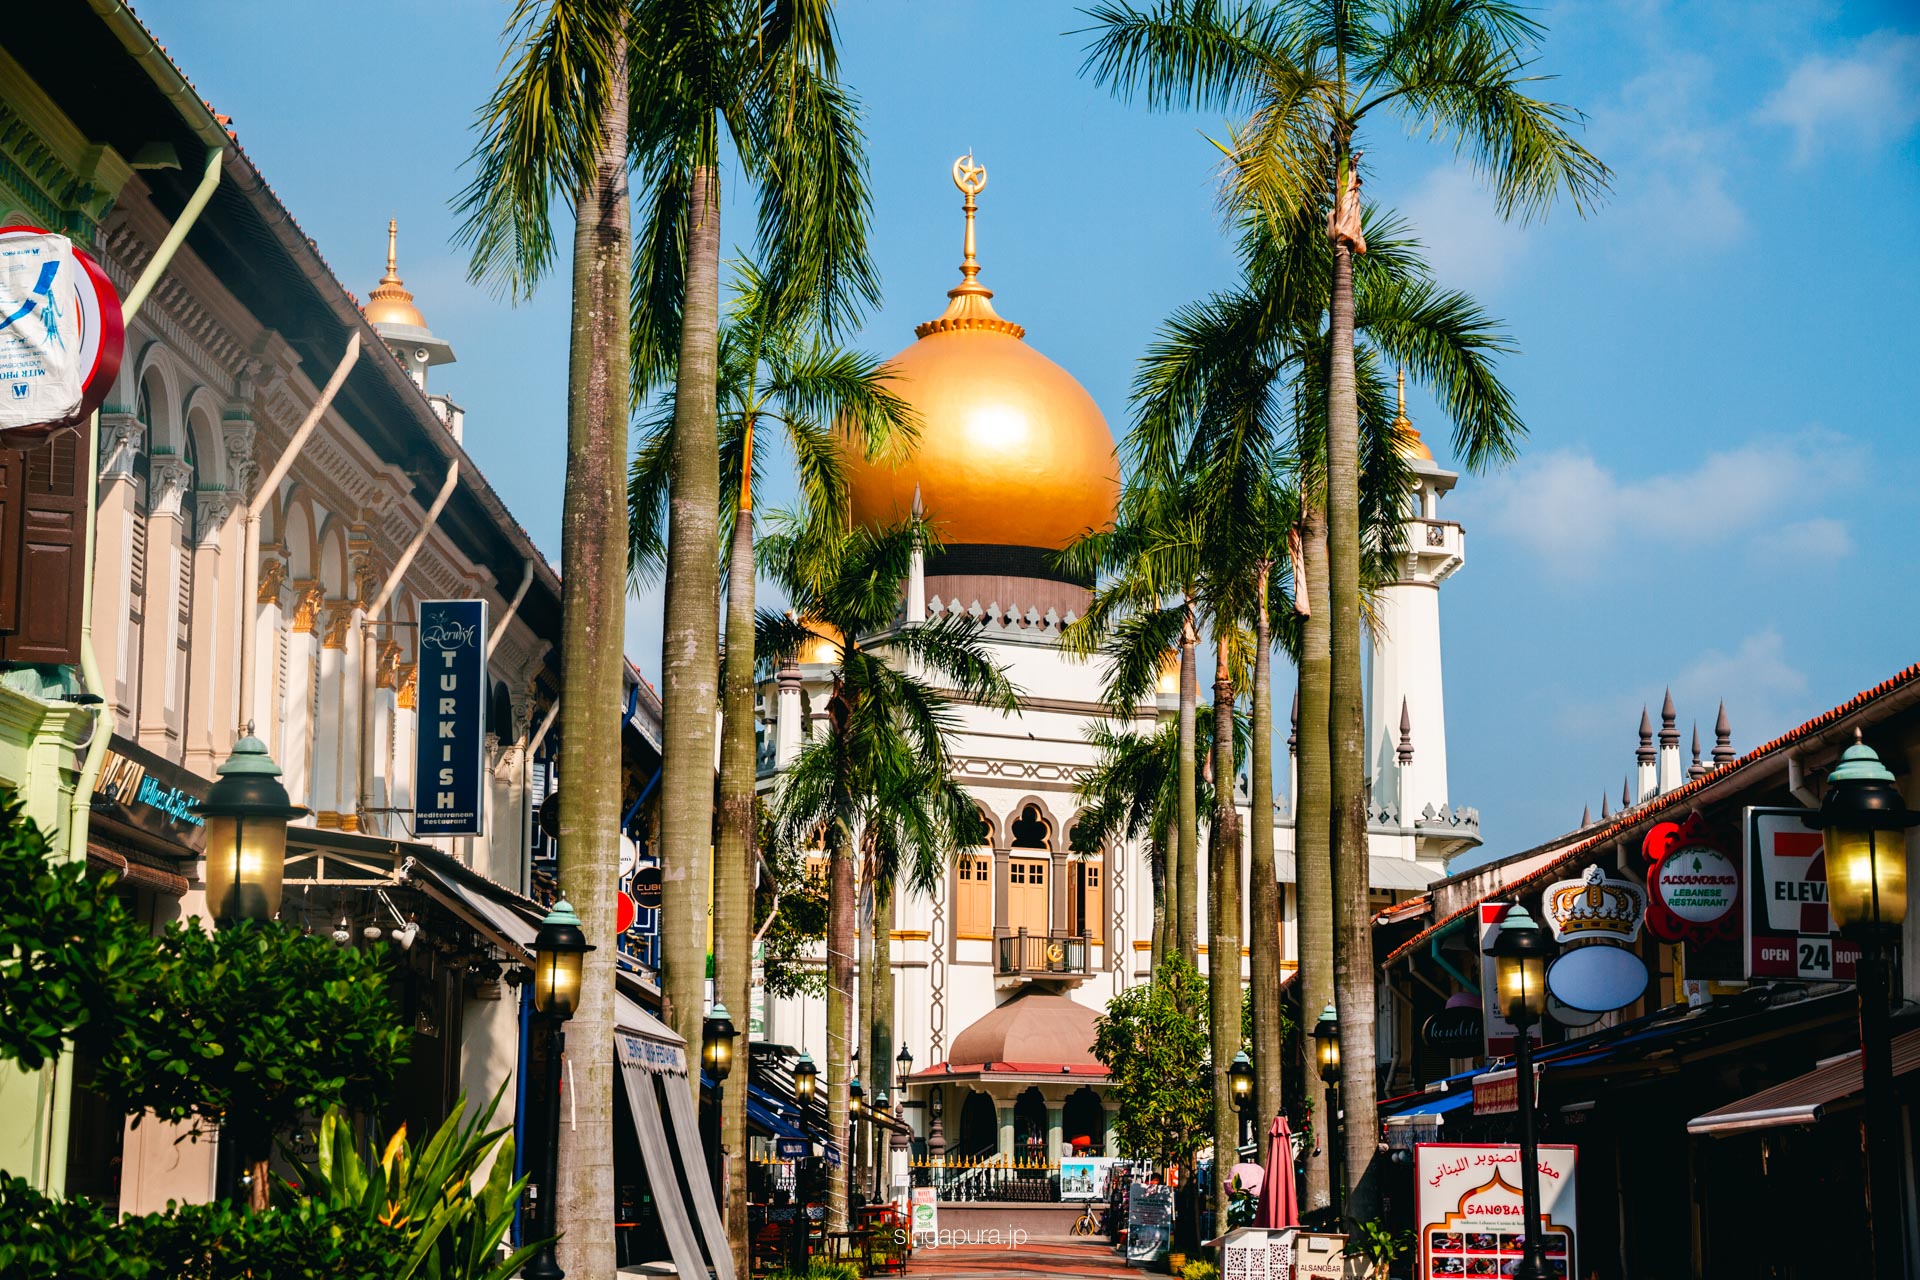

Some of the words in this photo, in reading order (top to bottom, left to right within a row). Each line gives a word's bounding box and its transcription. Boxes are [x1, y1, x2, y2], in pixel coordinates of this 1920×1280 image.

[0, 371, 18, 380] PHO
[21, 368, 45, 378] MITR
[437, 651, 457, 809] TURKISH
[417, 812, 474, 820] Mediterranean
[1661, 875, 1736, 885] ALSANOBAR
[1673, 888, 1722, 897] LEBANESE
[1775, 881, 1829, 902] ELEV
[1668, 898, 1728, 907] RESTAURANT
[1761, 948, 1790, 961] OPEN
[1799, 944, 1830, 971] 24
[1835, 951, 1863, 963] HOU
[1429, 1156, 1470, 1187] اللبناني
[1537, 1161, 1560, 1179] مطع
[1301, 1264, 1341, 1273] ALSANOBAR
